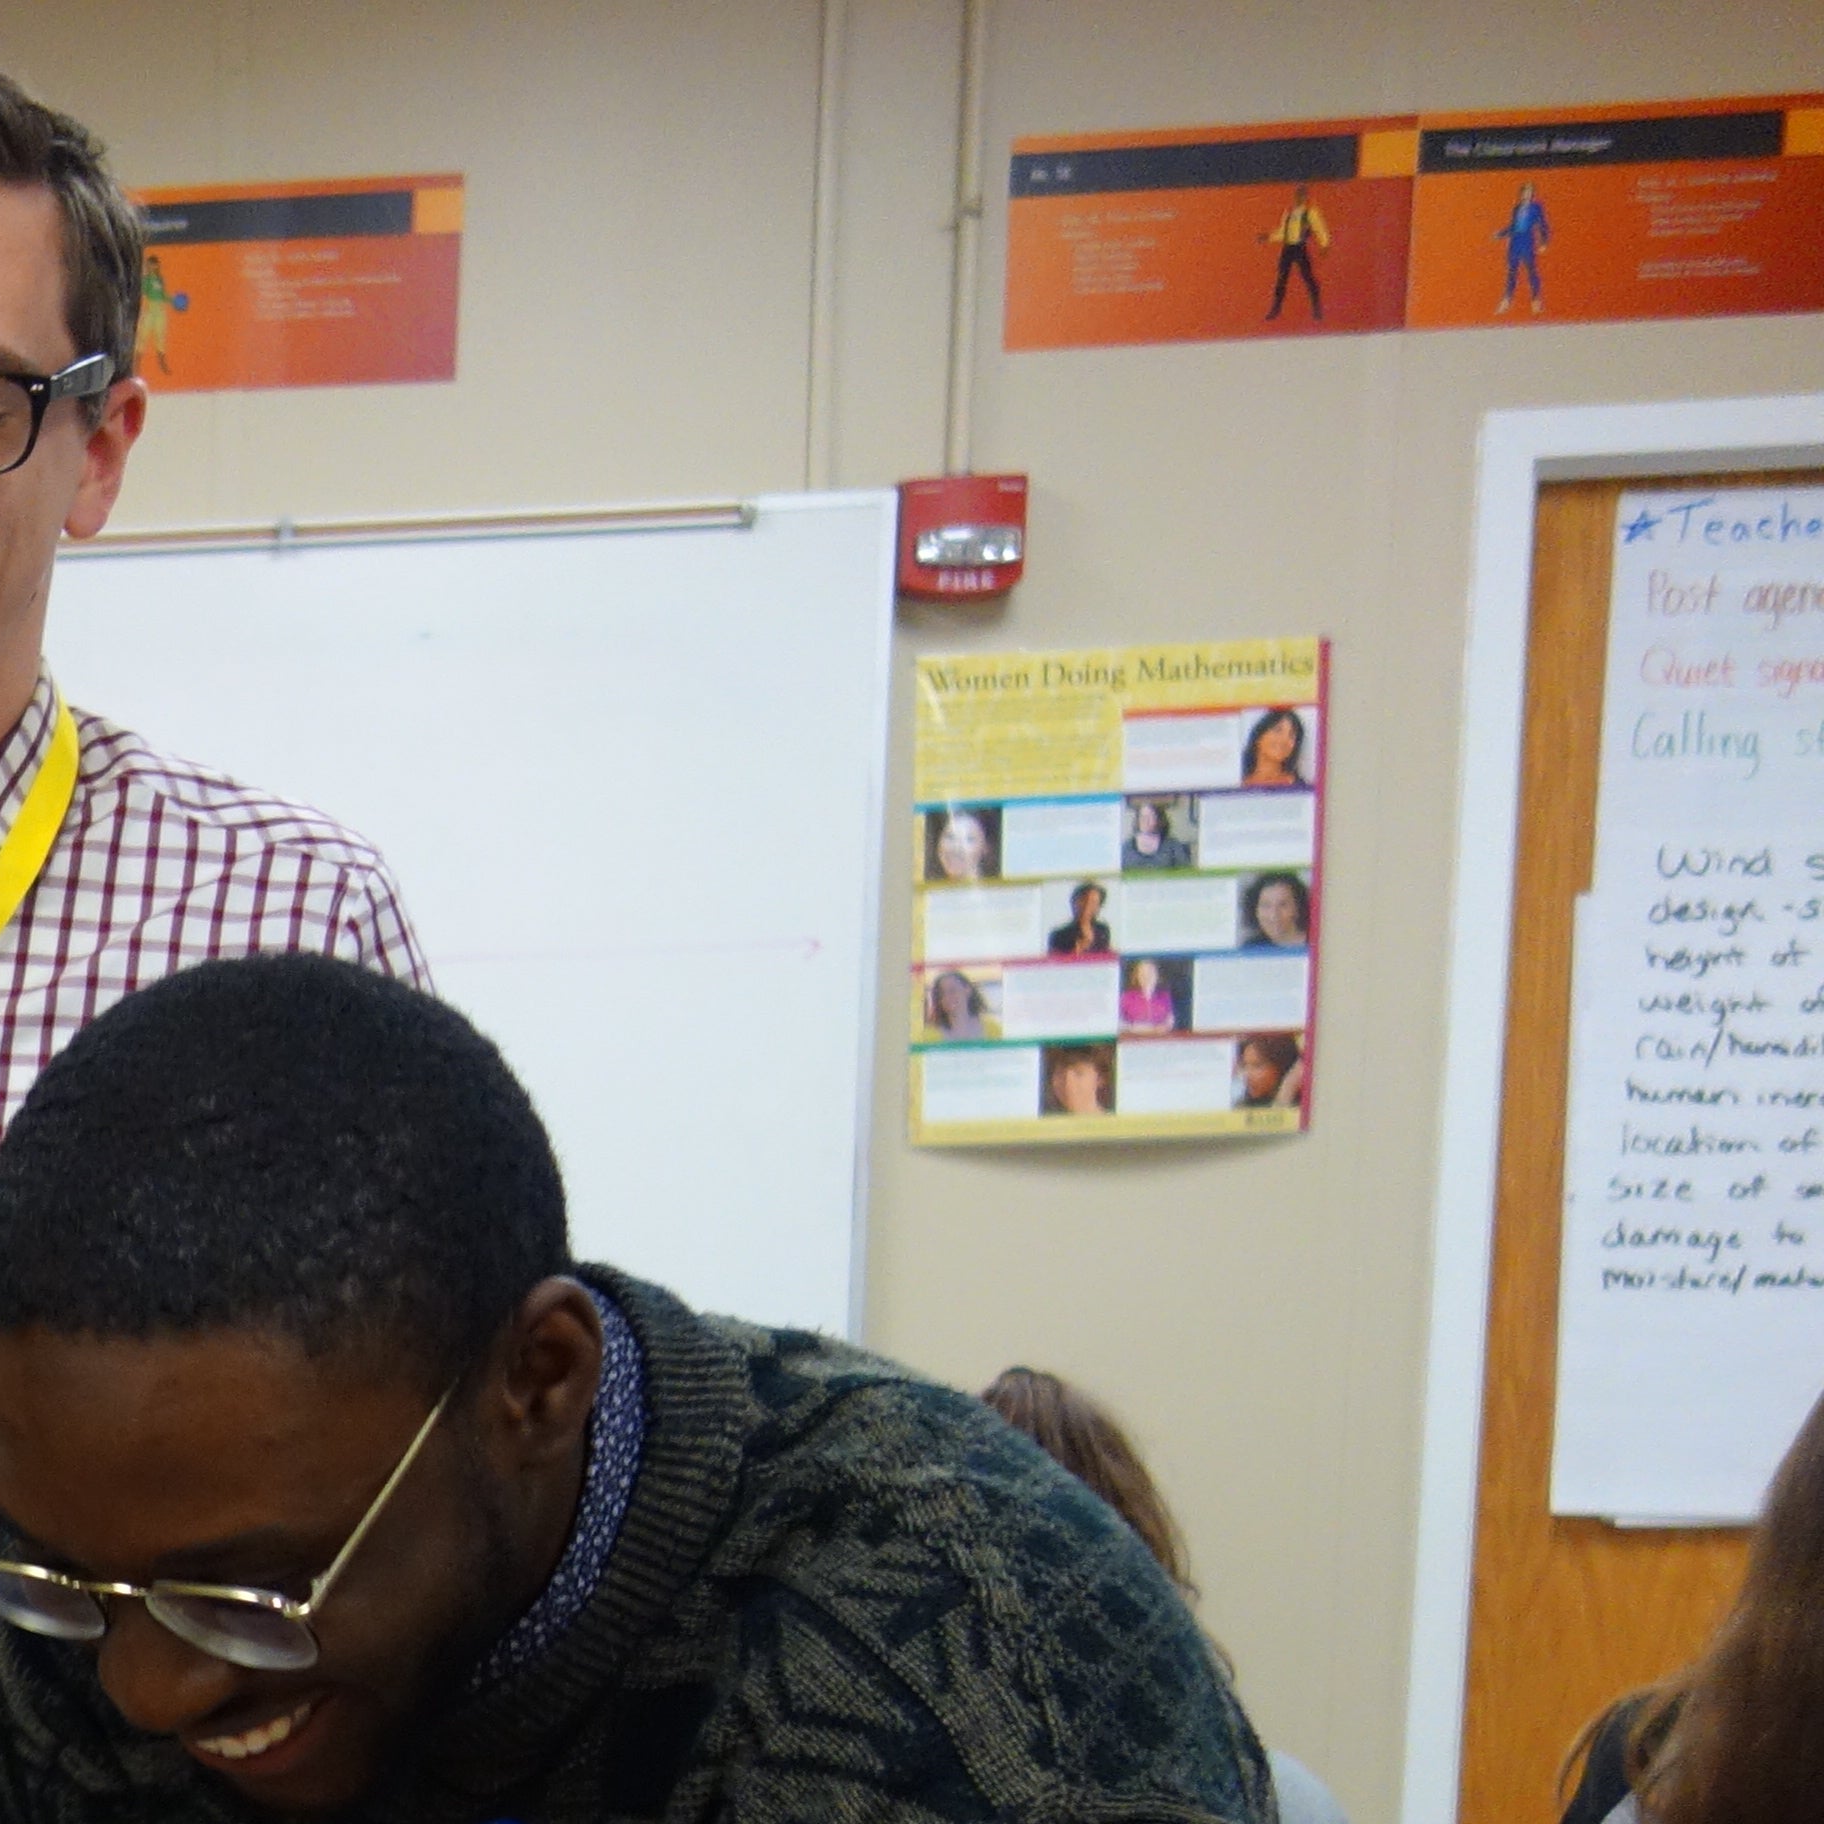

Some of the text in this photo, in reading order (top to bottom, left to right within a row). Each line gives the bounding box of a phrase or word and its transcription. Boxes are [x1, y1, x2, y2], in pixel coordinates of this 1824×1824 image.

[938, 569, 996, 592] FIRE
[928, 650, 1315, 694] Women Doing Mathematics
[1657, 843, 1772, 878] Wind
